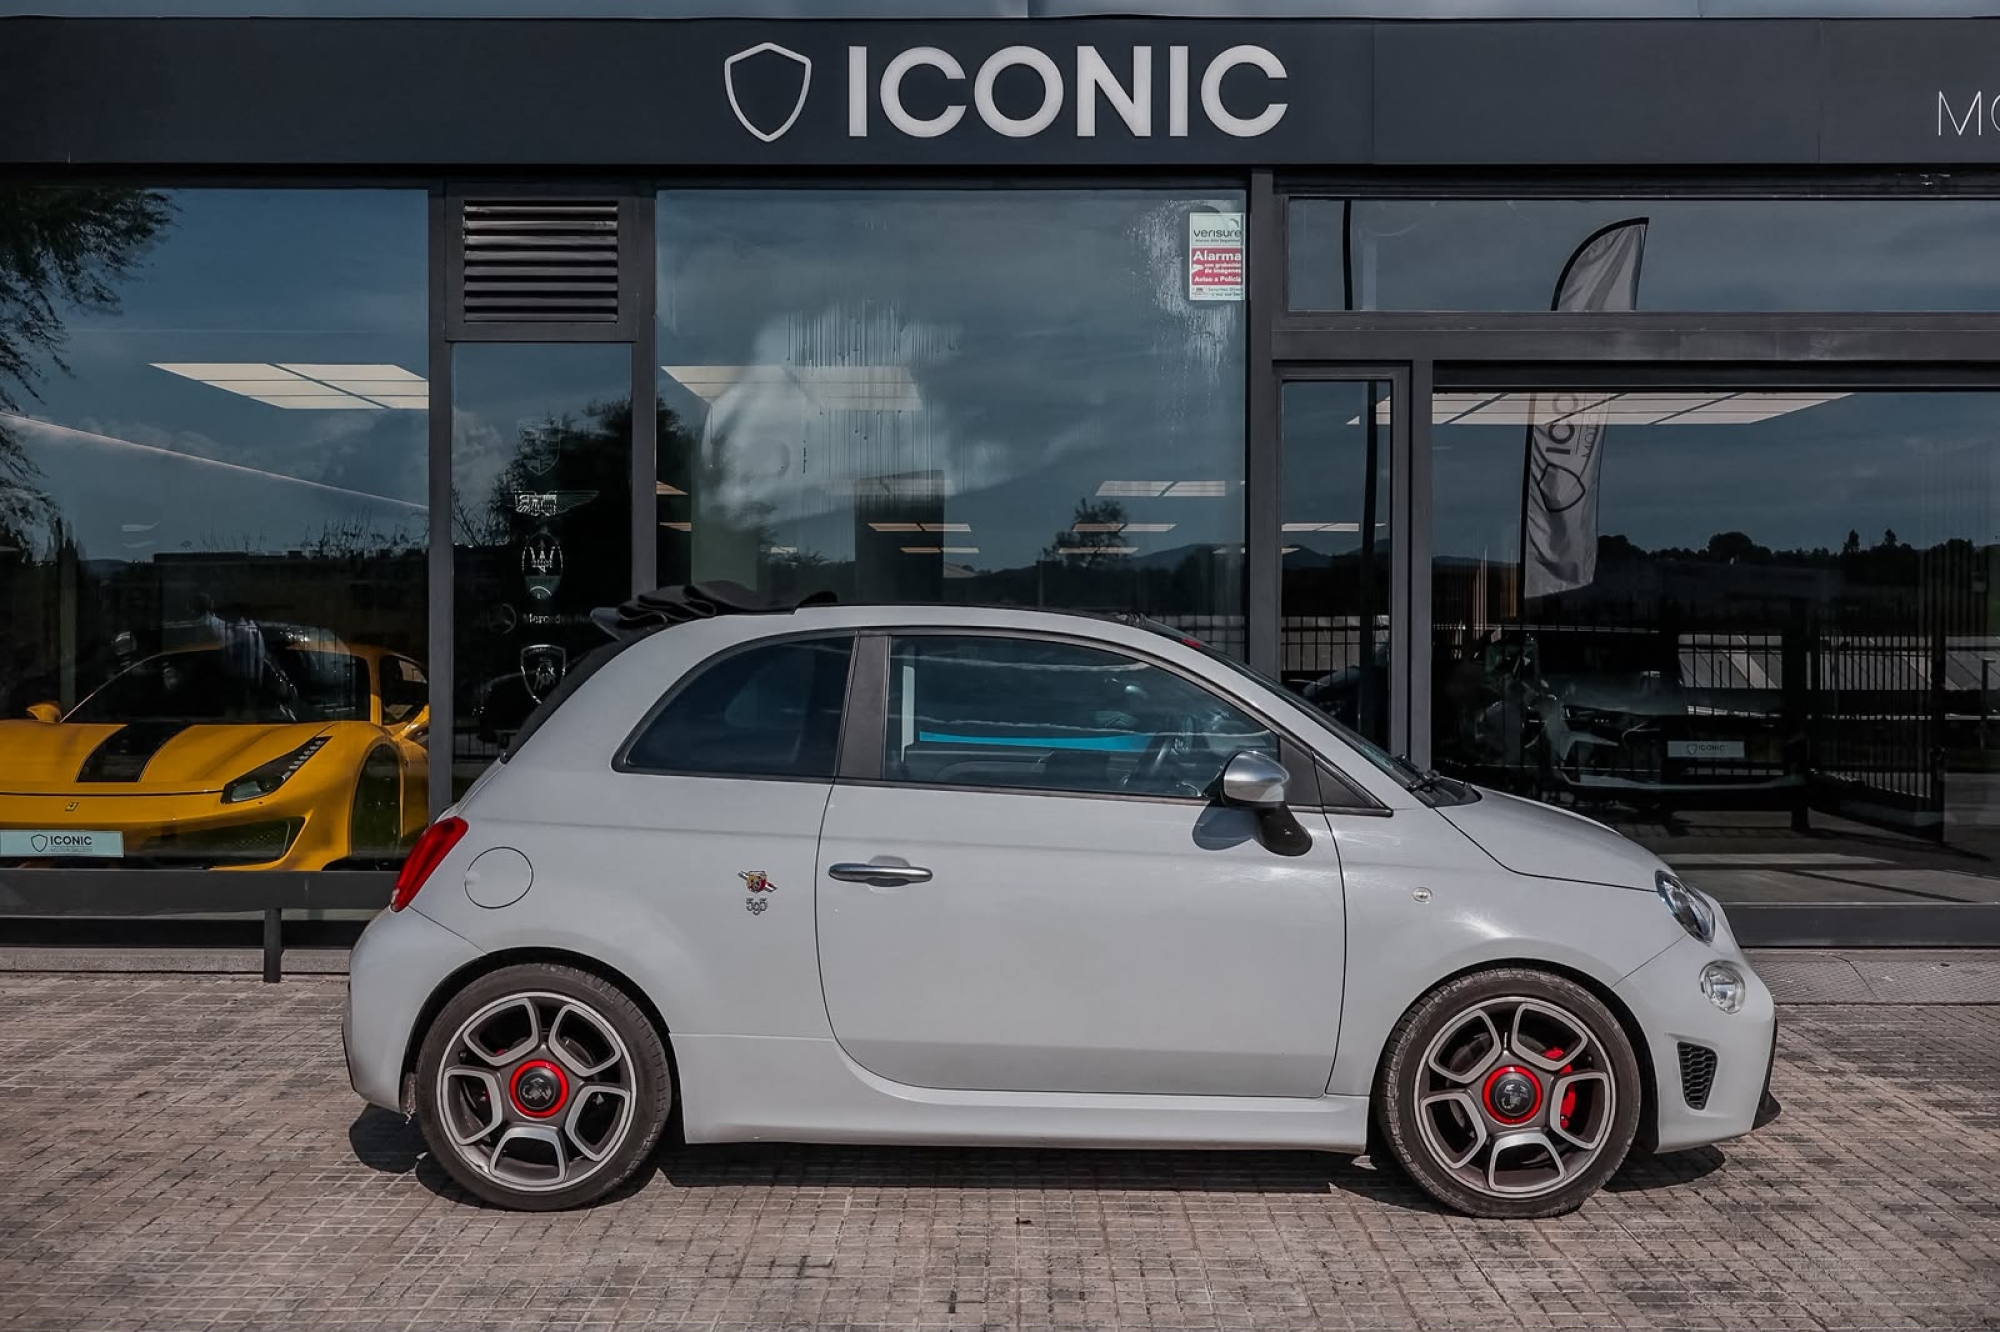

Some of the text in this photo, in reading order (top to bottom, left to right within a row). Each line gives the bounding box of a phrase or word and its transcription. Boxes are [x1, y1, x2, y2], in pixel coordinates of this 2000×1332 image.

[849, 45, 1288, 138] ICONIC
[1938, 90, 2000, 136] M
[1193, 229, 1242, 238] verisure
[1193, 250, 1242, 261] Alarma
[50, 835, 93, 846] ICONIC
